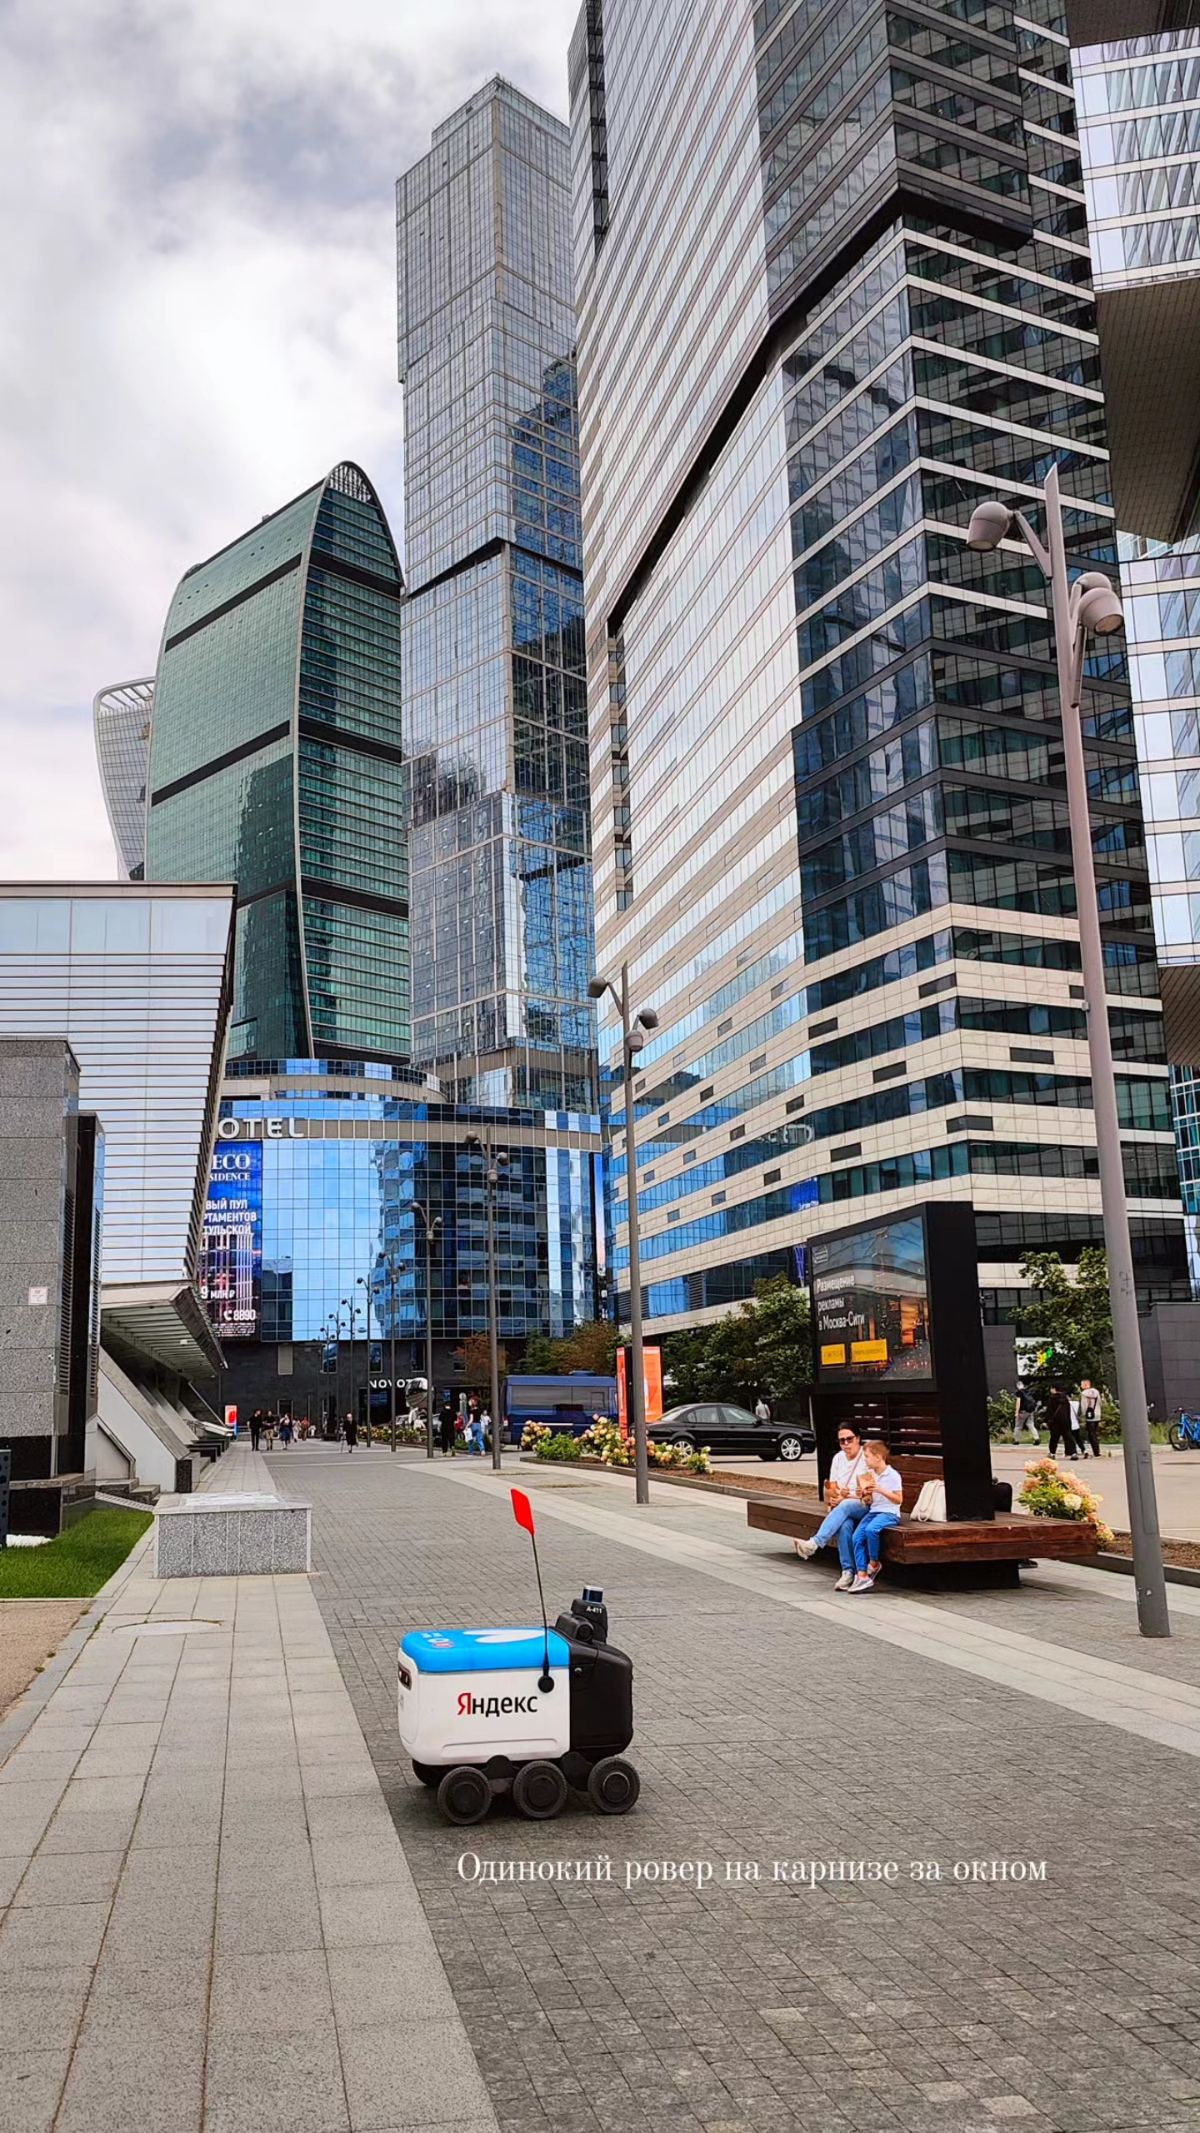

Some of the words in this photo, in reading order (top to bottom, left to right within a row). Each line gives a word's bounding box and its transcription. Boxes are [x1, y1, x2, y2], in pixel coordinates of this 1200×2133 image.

[218, 1117, 304, 1139] OTEL
[212, 1153, 251, 1169] ECO
[229, 1199, 248, 1210] ПУЛ
[816, 1274, 855, 1293] Размещение
[817, 1297, 845, 1315] рекламы
[823, 1311, 865, 1330] Москва-Сити
[457, 1693, 538, 1717] Яндекс
